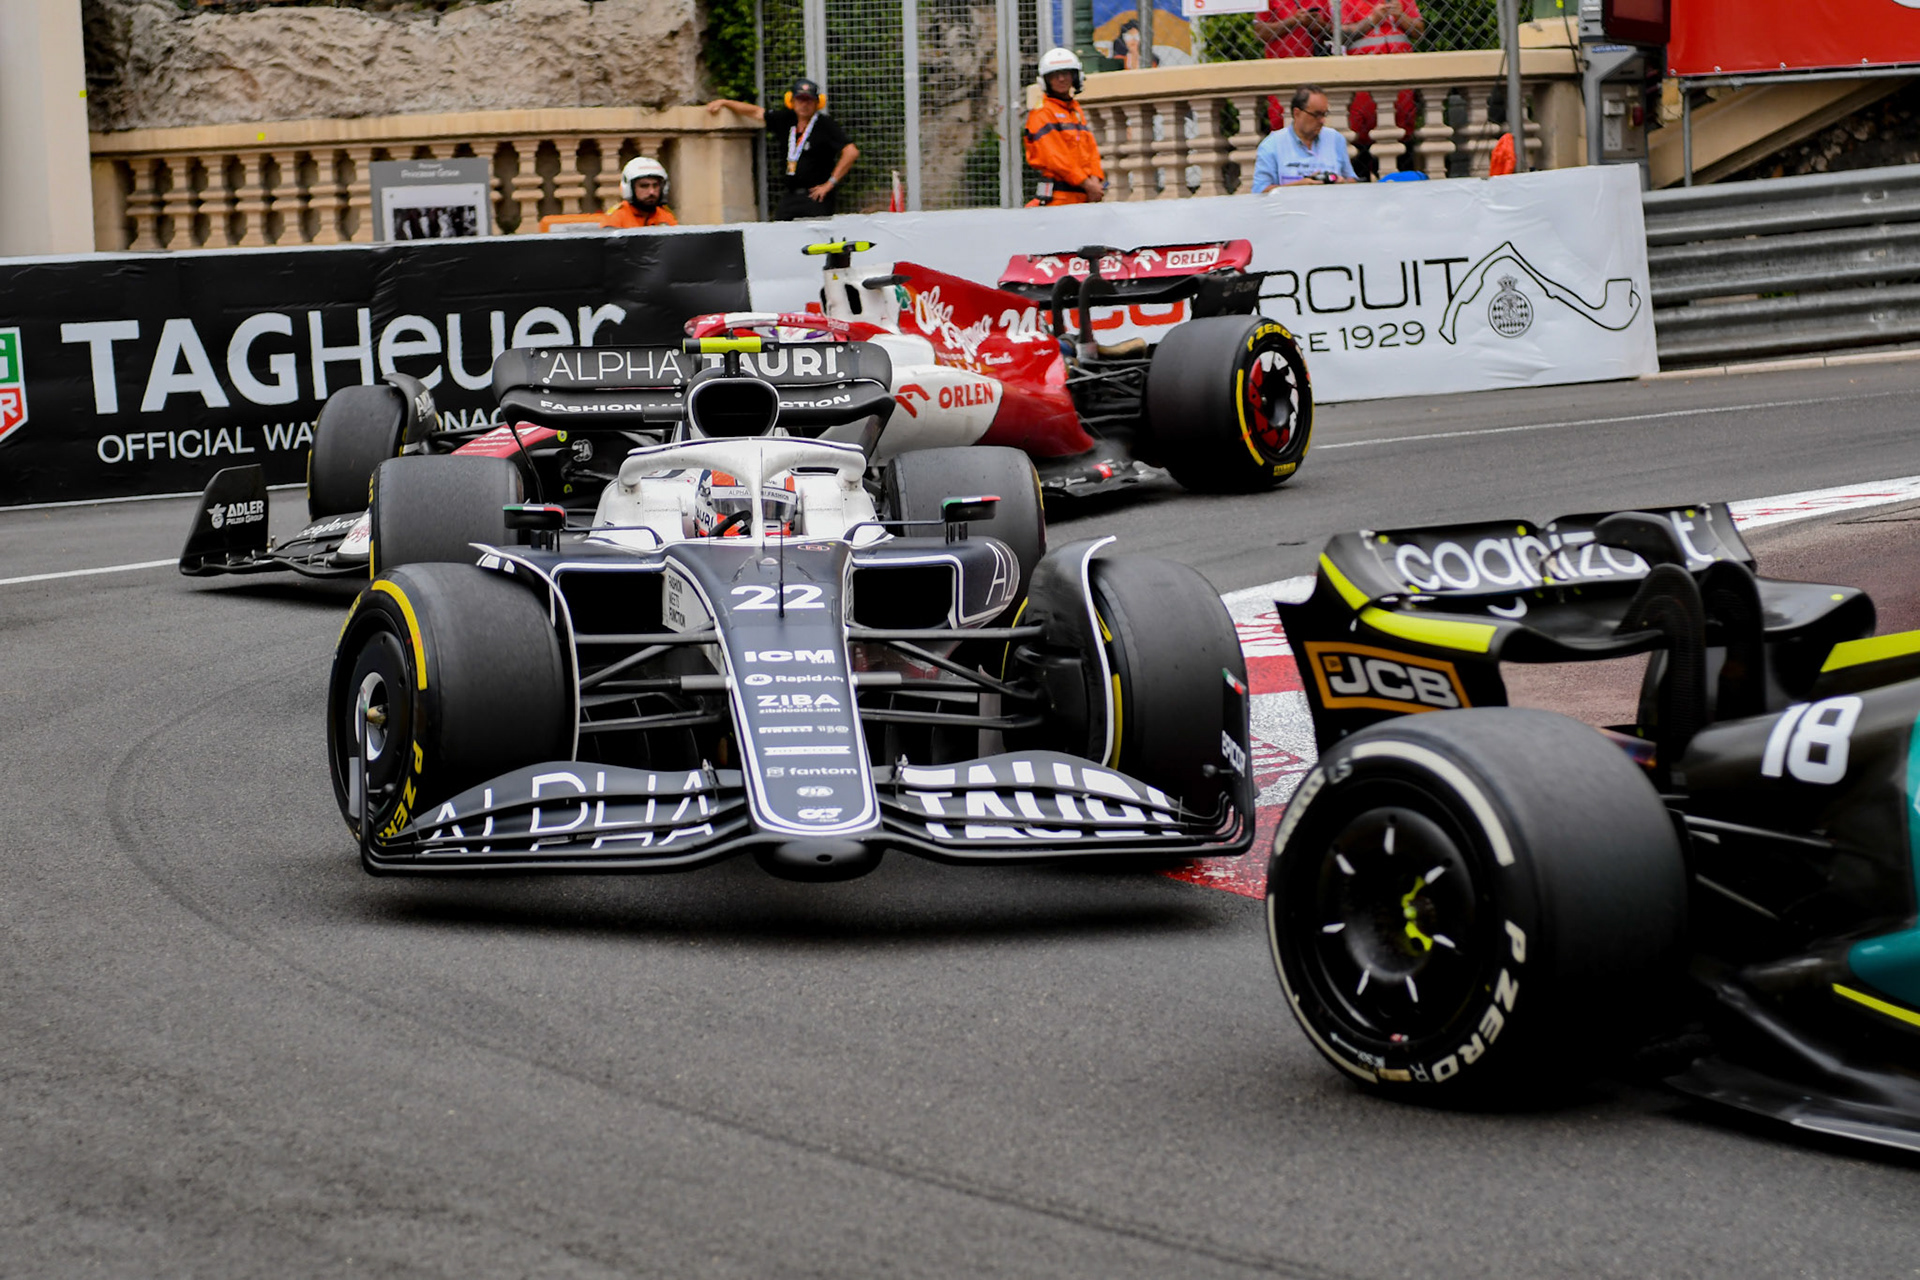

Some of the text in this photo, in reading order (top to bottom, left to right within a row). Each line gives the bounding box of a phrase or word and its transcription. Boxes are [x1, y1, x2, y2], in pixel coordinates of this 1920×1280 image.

[1171, 251, 1215, 266] ORLEN
[1257, 256, 1469, 316] RCUIT
[998, 306, 1048, 344] 24
[1255, 323, 1292, 341] ZERO
[1338, 320, 1425, 352] 1929
[548, 350, 683, 382] ALPHA
[540, 394, 851, 413] FASHION CTION
[938, 382, 994, 410] ORLEN
[97, 425, 255, 464] OFFICIAL
[226, 500, 264, 518] ADLER
[730, 583, 826, 611] 22
[744, 649, 835, 663] ICM
[1328, 655, 1460, 709] JCB
[757, 693, 840, 707] ZIBA
[1760, 695, 1864, 784] 18
[413, 739, 424, 775] P
[788, 767, 858, 776] fantom
[420, 770, 714, 854] ALPHA
[1431, 918, 1527, 1083] P ZERO
